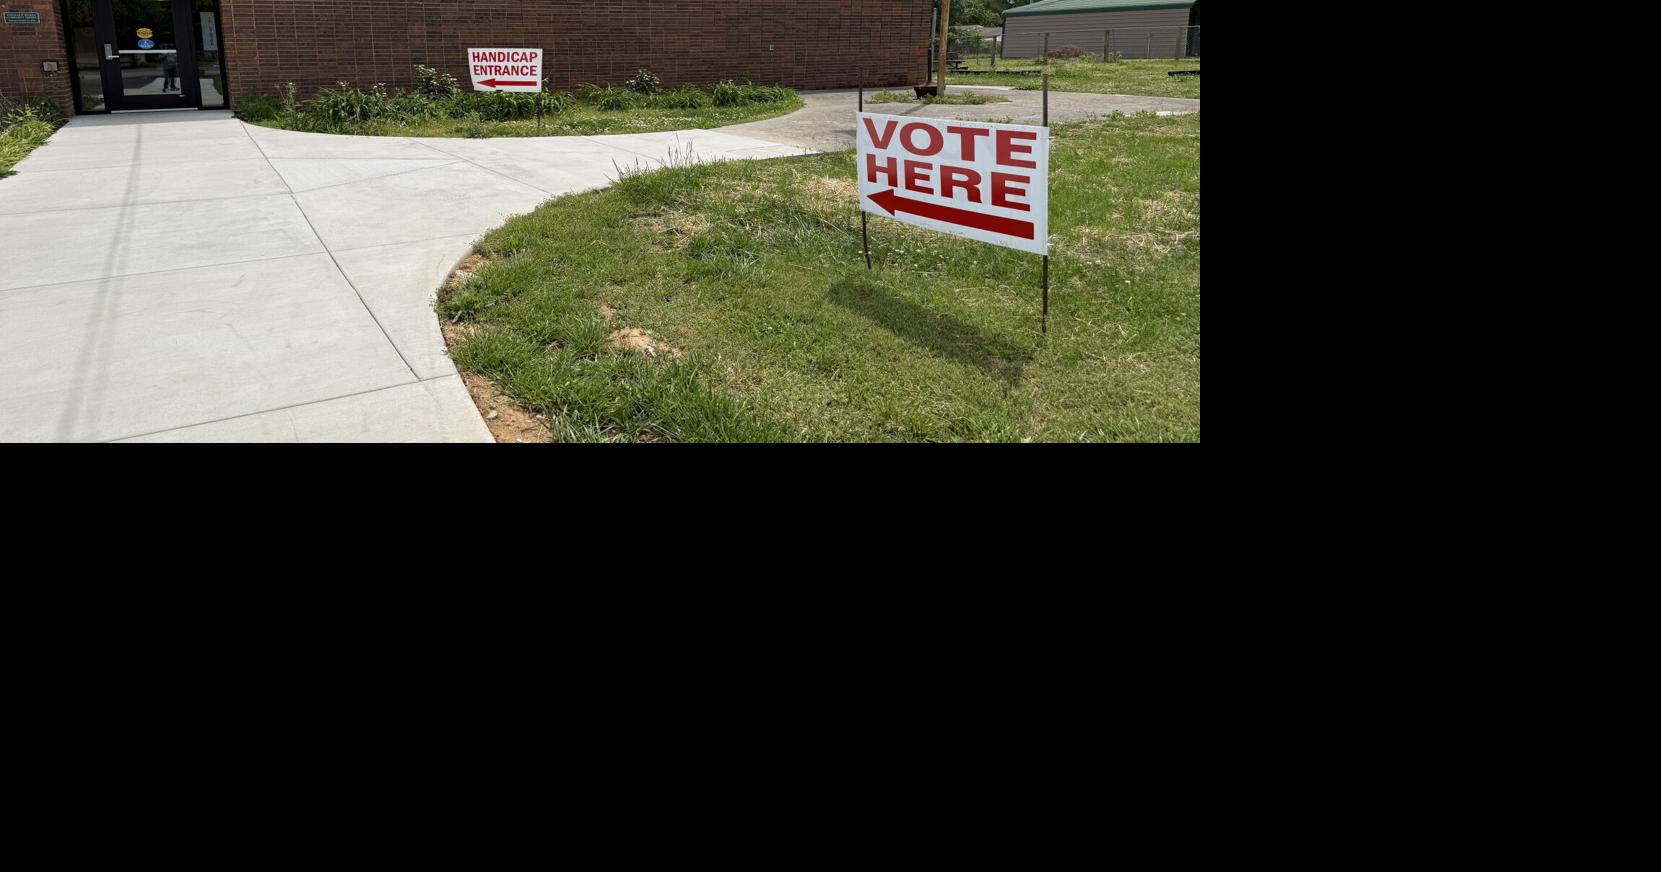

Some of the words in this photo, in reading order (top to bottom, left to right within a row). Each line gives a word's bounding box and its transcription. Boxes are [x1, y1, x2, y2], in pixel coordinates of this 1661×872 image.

[472, 51, 538, 63] HANDICAP
[473, 64, 538, 76] ENTRANCE
[863, 117, 1037, 169] VOTE
[866, 153, 1031, 212] HERE
